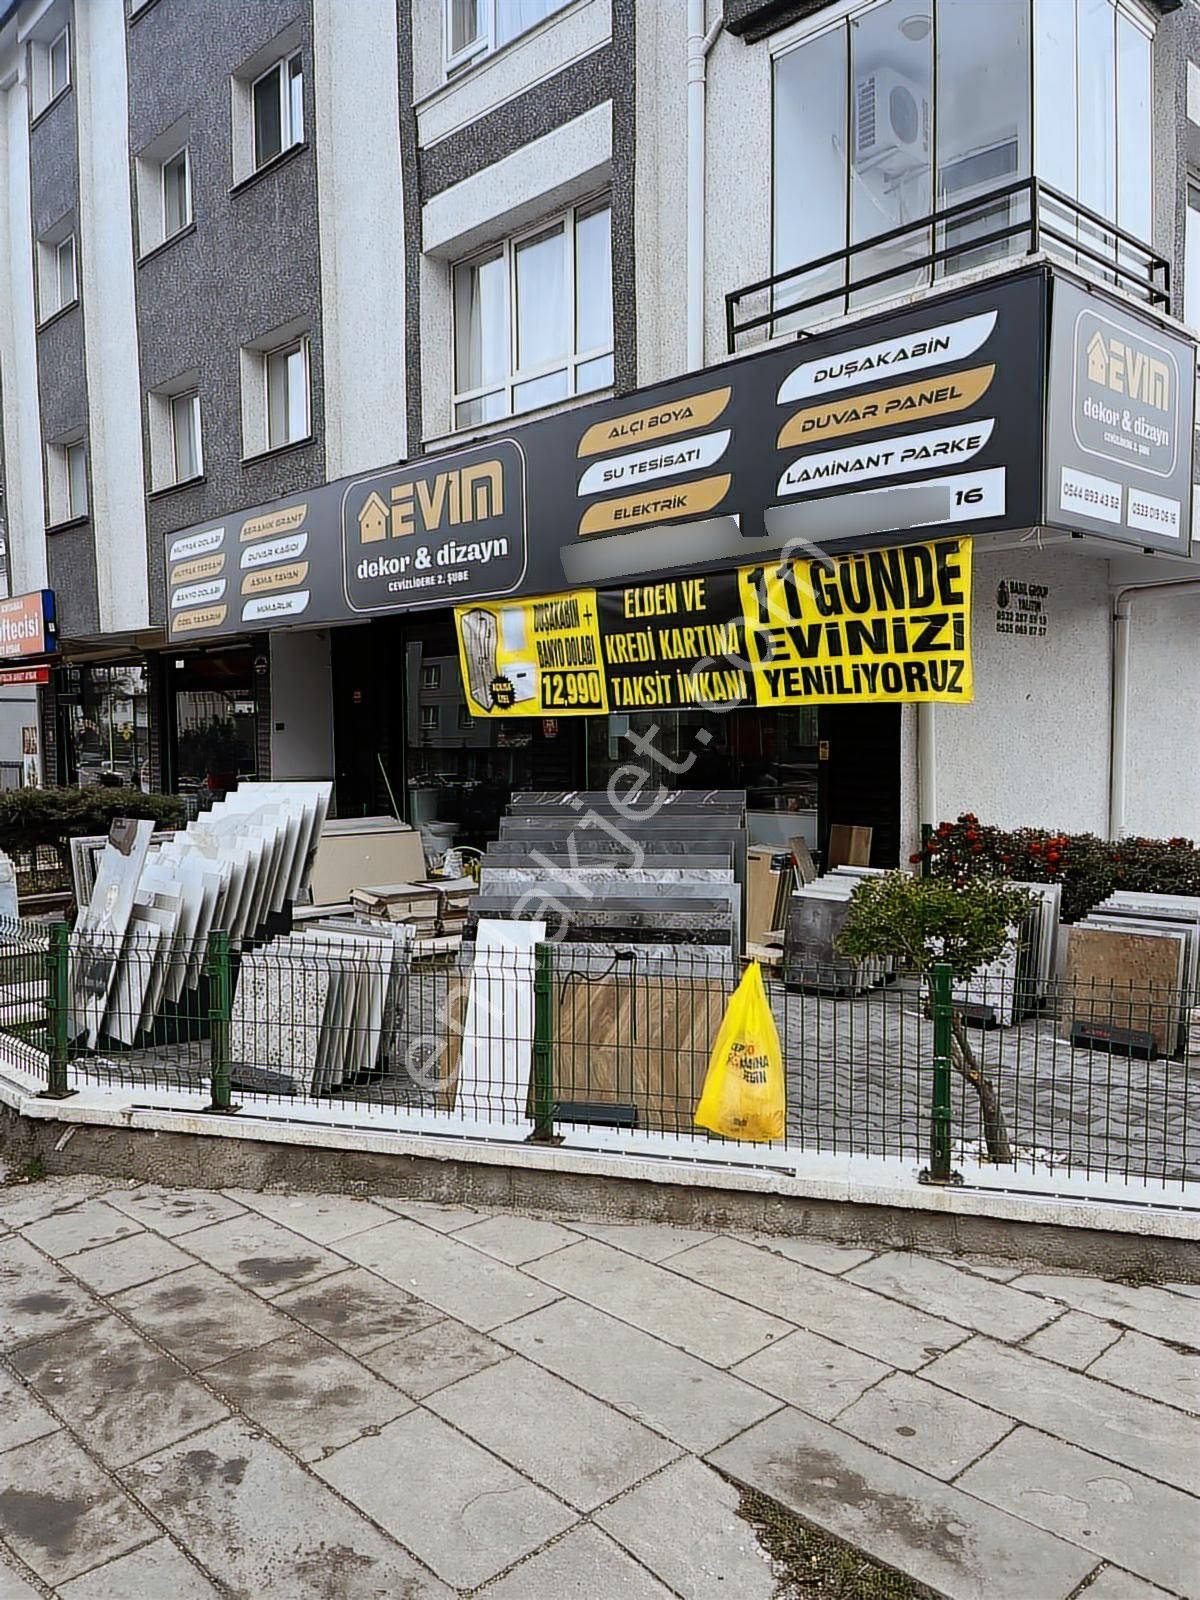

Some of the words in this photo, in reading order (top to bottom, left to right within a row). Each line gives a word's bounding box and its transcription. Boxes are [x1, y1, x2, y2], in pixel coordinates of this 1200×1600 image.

[813, 335, 950, 384] DUŞAKABİN
[608, 420, 644, 439] ALÇI
[648, 407, 694, 428] BOYA
[801, 405, 878, 433] DUVAR
[884, 386, 963, 413] PANEL
[1083, 397, 1120, 427] dekor
[1121, 409, 1132, 433] &
[1134, 416, 1169, 447] dizayn
[603, 467, 624, 482] SU
[629, 448, 701, 476] TESİSATI
[786, 452, 894, 485] LAMİNANT
[900, 435, 982, 463] PARKE
[613, 494, 688, 520] ELEKTRİK
[955, 487, 984, 506] 16
[357, 555, 411, 580] dekor
[414, 546, 432, 570] &
[436, 537, 508, 567] dizayn
[388, 575, 436, 592] CEVİZLİDERE
[447, 570, 470, 586] ŞUBE
[624, 584, 678, 618] ELDEN
[681, 578, 706, 612] VE
[747, 562, 803, 624] 11
[809, 541, 964, 616] GÜNDE
[604, 626, 657, 664] KREDİ
[658, 622, 741, 660] KARTINA
[542, 671, 601, 707] 12,990
[611, 669, 672, 706] TAKSİT
[676, 668, 743, 703] İMKANI
